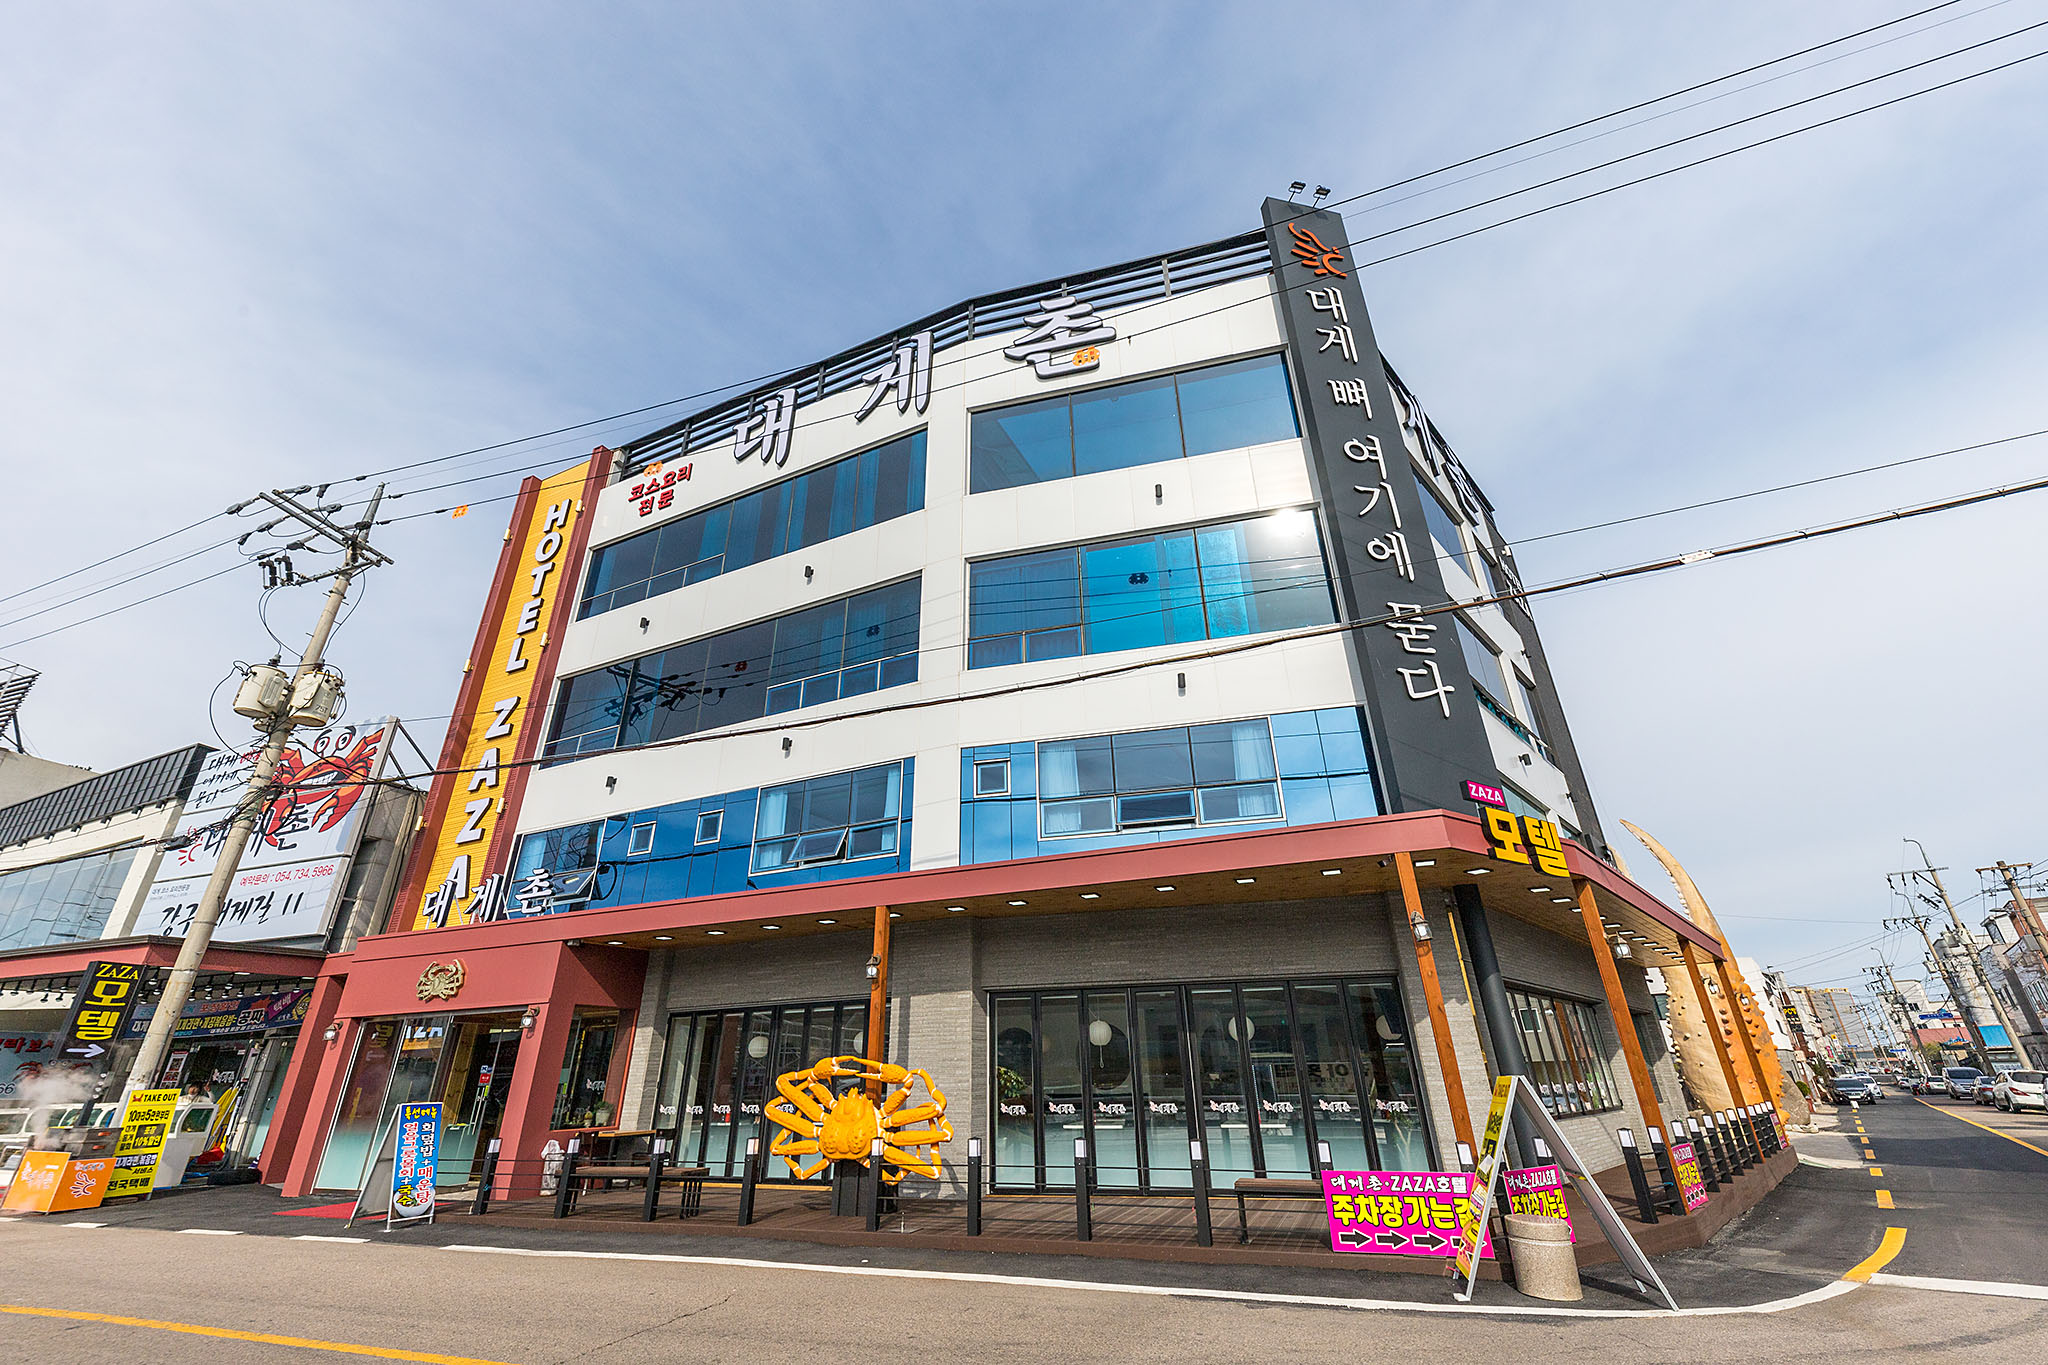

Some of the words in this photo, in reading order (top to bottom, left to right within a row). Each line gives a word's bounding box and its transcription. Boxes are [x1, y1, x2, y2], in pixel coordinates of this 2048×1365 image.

[1306, 286, 1358, 364] 대게
[733, 295, 1117, 468] 대게촌
[1327, 377, 1373, 420] 뼈
[628, 463, 693, 502] 코스요리
[638, 489, 675, 516] 전문
[1344, 434, 1415, 582] 여기에
[505, 498, 573, 675] HOTEL
[446, 696, 521, 899] ZAZA
[1469, 783, 1504, 804] ZAZA
[1483, 806, 1570, 878] 모텔
[275, 864, 335, 884] 054.734.5966
[282, 891, 304, 916] 11
[422, 869, 553, 929] 대게촌
[95, 963, 139, 980] ZAZA
[76, 980, 130, 1040] 모텔
[238, 1008, 266, 1025] 공짜
[144, 1094, 160, 1102] TAKE
[162, 1093, 177, 1102] OUT
[107, 1177, 150, 1190] 전국택배
[1331, 1194, 1404, 1228] 주차장
